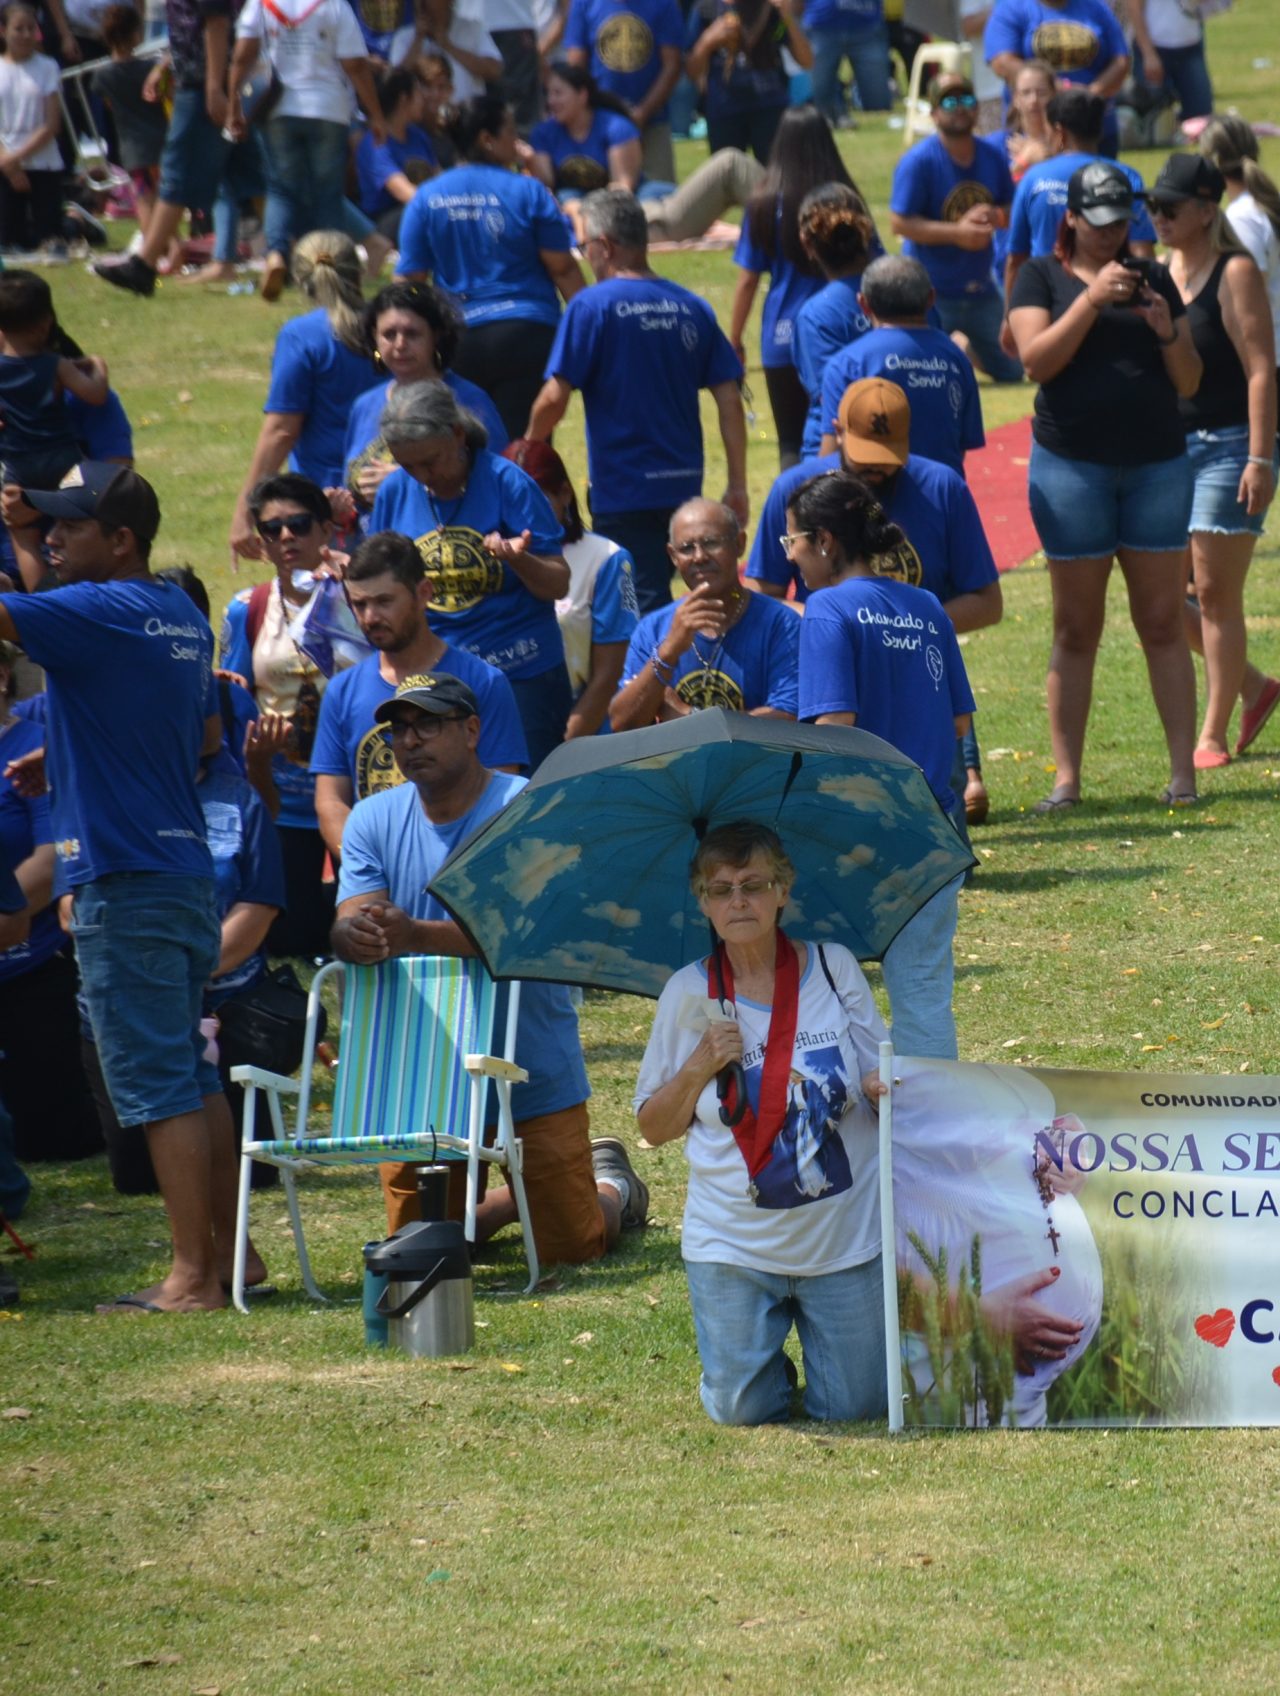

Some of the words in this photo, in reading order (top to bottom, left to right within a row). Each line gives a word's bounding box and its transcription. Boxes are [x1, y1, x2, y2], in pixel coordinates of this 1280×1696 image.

[615, 296, 680, 318] Chamado
[884, 352, 949, 371] Chamado
[144, 617, 200, 639] Chamado
[856, 606, 924, 630] Chamado
[928, 620, 939, 635] a
[882, 629, 923, 652] Servir!
[794, 1027, 839, 1050] Maria
[1033, 1130, 1205, 1173] NOSSA
